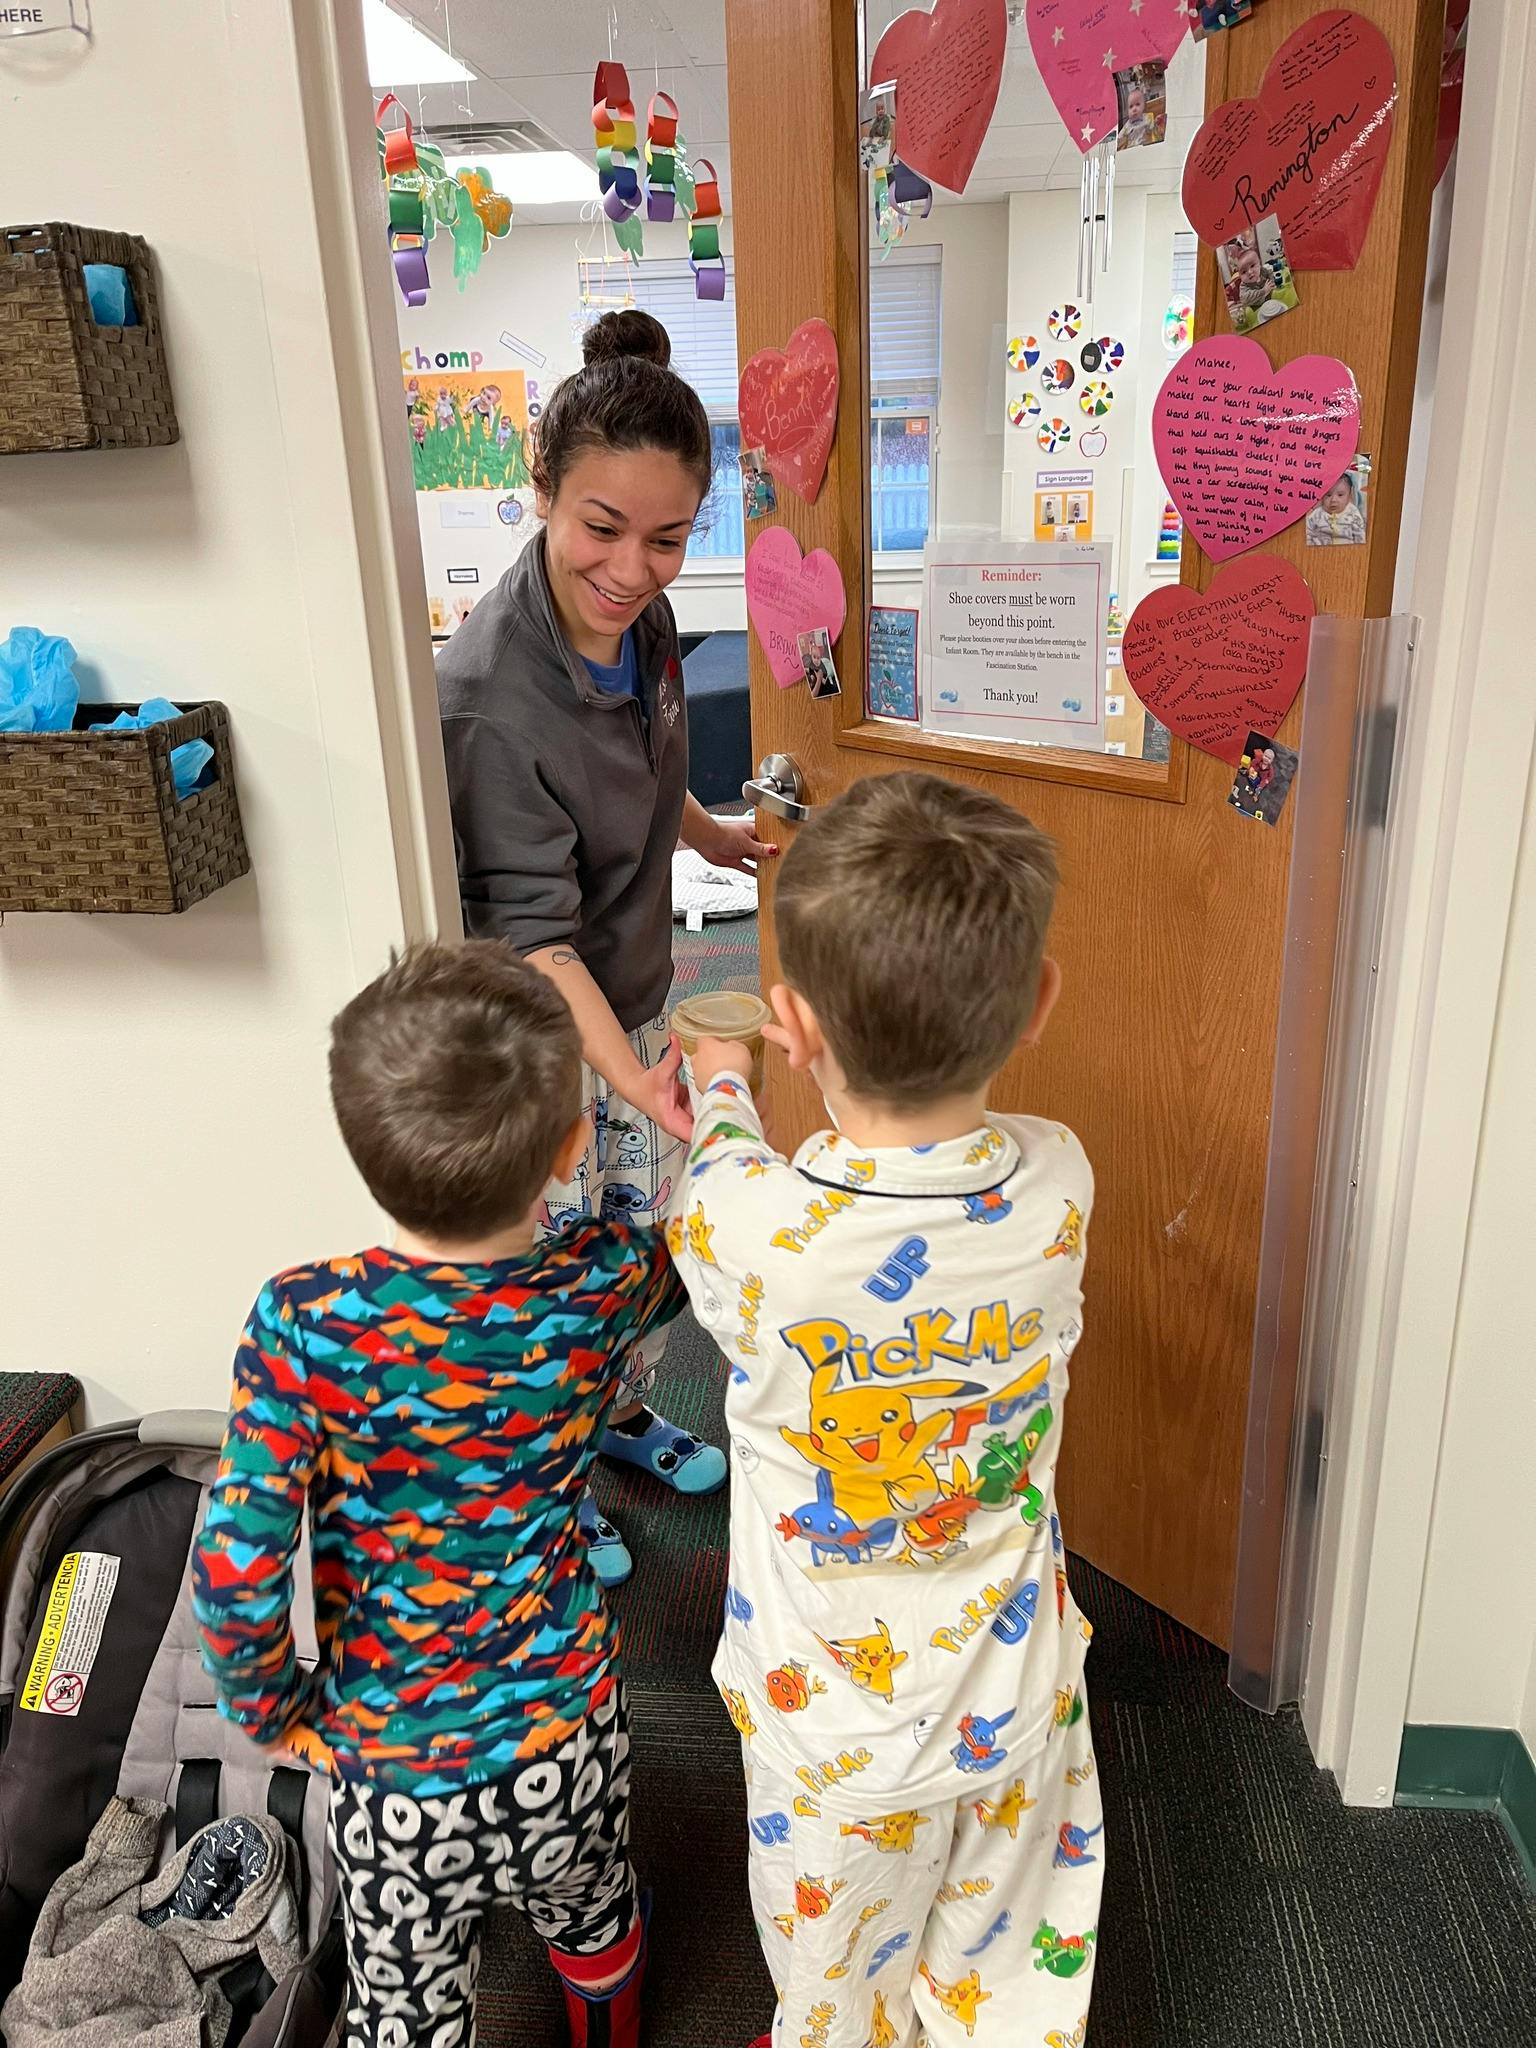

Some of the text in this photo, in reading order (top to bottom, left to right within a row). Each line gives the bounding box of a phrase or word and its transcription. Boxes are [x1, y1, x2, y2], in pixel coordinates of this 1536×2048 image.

[1229, 103, 1359, 226] Remington
[1176, 375, 1342, 408] We love your radiant smile, that
[765, 380, 819, 441] Benny
[1167, 391, 1194, 401] makes
[1224, 397, 1250, 409] hearts
[1257, 402, 1276, 416] light
[1283, 407, 1293, 418] up
[1166, 409, 1189, 420] stand
[1222, 415, 1233, 424] We
[1240, 416, 1258, 427] love
[1289, 425, 1306, 435] little
[1313, 429, 1341, 444] fingers
[1168, 428, 1326, 455] that hold ours so tight, and those
[1173, 446, 1322, 470] soft squishable cheeks! We love
[1175, 462, 1323, 489] the tiny funny sounds you make
[1183, 492, 1289, 513] We love your calm, like
[1227, 480, 1269, 496] screeching
[1275, 486, 1283, 495] to
[1299, 491, 1320, 502] halt.
[1186, 505, 1267, 522] the warmth of the
[1196, 518, 1211, 526] sun
[1217, 521, 1250, 536] shining
[1222, 533, 1249, 544] faces.
[982, 569, 1042, 582] Reminder:
[949, 592, 1076, 607] Shoe covers must be worn
[1133, 574, 1283, 634] We love EVERYTHING about
[968, 614, 1055, 631] beyond this point.
[1172, 621, 1213, 642] Bradley
[769, 630, 798, 657] BRYAN
[940, 634, 956, 643] Please
[957, 634, 971, 645] place
[972, 634, 991, 643] booties
[1005, 638, 1017, 646] your
[1018, 637, 1031, 645] shoes
[1032, 637, 1050, 646] before
[1051, 638, 1076, 649] entering
[1077, 639, 1087, 647] the
[945, 646, 961, 655] Infant
[963, 647, 980, 656] Room.
[981, 648, 994, 658] They
[1004, 649, 1028, 659] available
[1029, 651, 1036, 661] by
[1037, 650, 1045, 659] the
[1046, 651, 1063, 661] bench
[1064, 652, 1070, 660] in
[1071, 651, 1081, 661] the
[986, 661, 1038, 672] Fascination Station.
[1246, 652, 1284, 672] Fangs)
[983, 688, 1038, 706] Thank you!
[862, 1235, 931, 1303] UP
[49, 1552, 78, 1631] ADVERTENCIA
[990, 1578, 1041, 1645] UP
[28, 1636, 56, 1692] WARNING
[750, 1811, 791, 1847] UP
